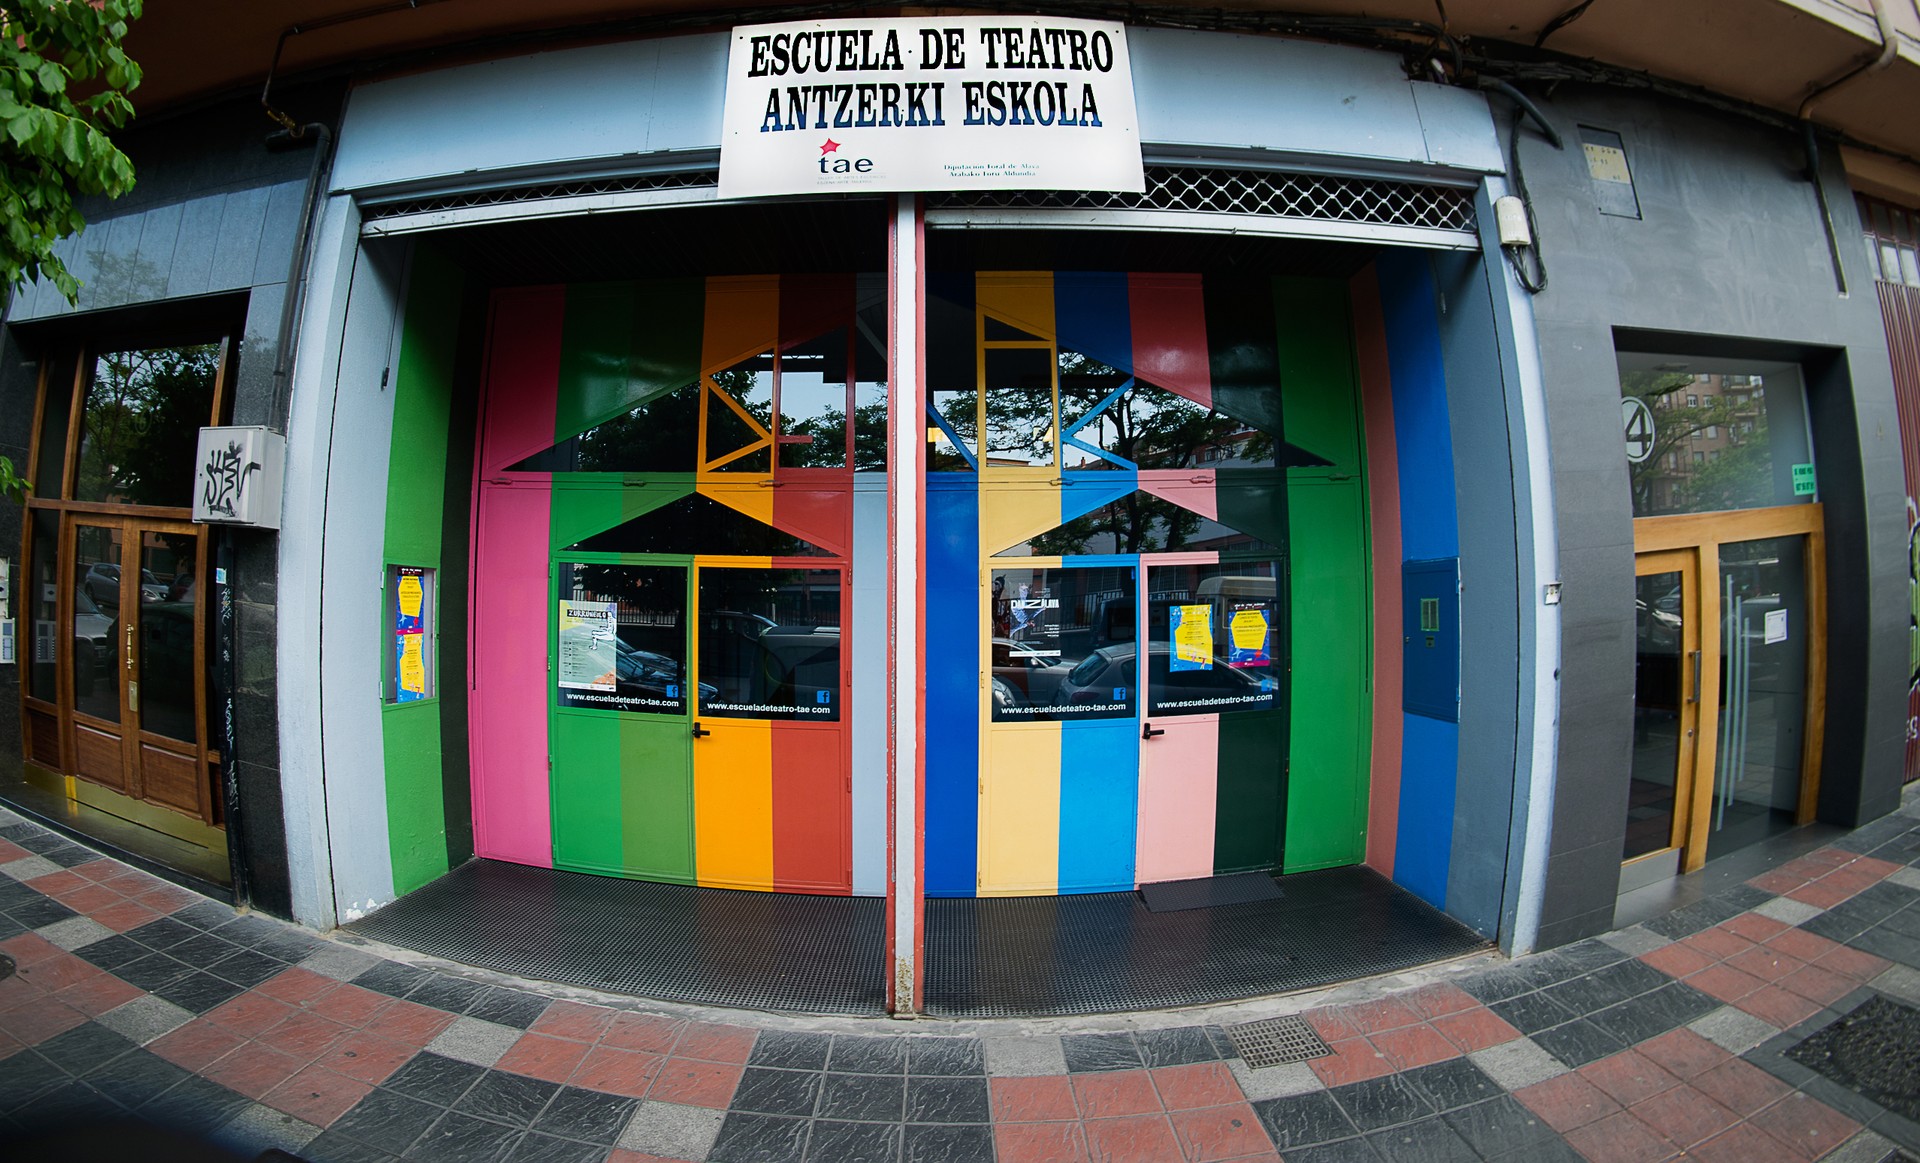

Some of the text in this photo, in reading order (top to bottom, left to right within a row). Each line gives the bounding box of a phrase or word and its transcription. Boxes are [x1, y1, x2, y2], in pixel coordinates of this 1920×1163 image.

[748, 28, 1113, 78] ESCUELA DE TEATRO
[760, 81, 1102, 133] ANTZERKI ESKOLA
[818, 157, 874, 174] tae
[1625, 404, 1653, 456] 4
[566, 693, 680, 708] www.escueladeteatro-tae.com
[1001, 703, 1126, 714] www.escueladeteatro-tae.com
[1157, 694, 1273, 709] www.escueladeteatro-tae.com
